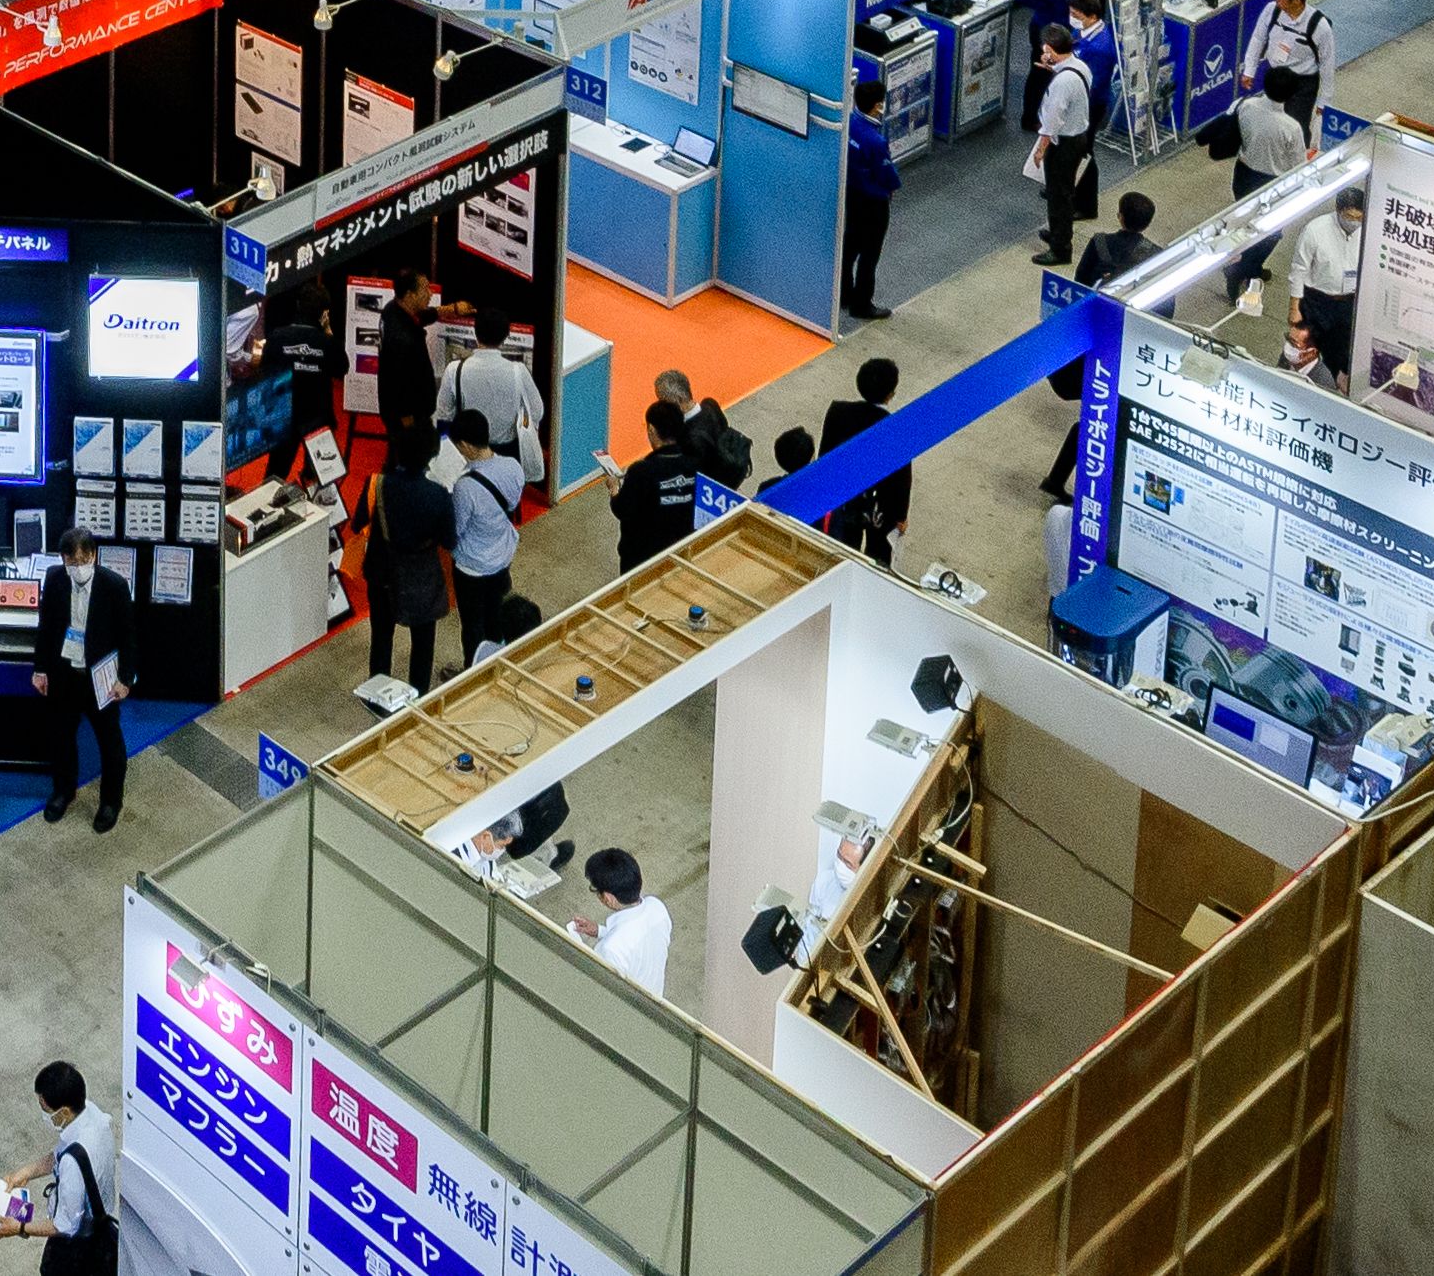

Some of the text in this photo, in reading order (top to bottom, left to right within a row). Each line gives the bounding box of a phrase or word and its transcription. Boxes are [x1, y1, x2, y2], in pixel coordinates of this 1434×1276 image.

[1, 7, 140, 80] PERFORMANCE
[1190, 69, 1234, 100] FUKUDA
[570, 75, 603, 98] 312
[230, 238, 261, 266] 311
[102, 312, 181, 332] Daitron
[1134, 367, 1337, 476] ブレーキ材料評価機
[157, 1020, 270, 1128] エンジン
[156, 1071, 268, 1181] マフラー
[326, 1077, 402, 1172] 温度
[348, 1177, 442, 1268] タイヤ
